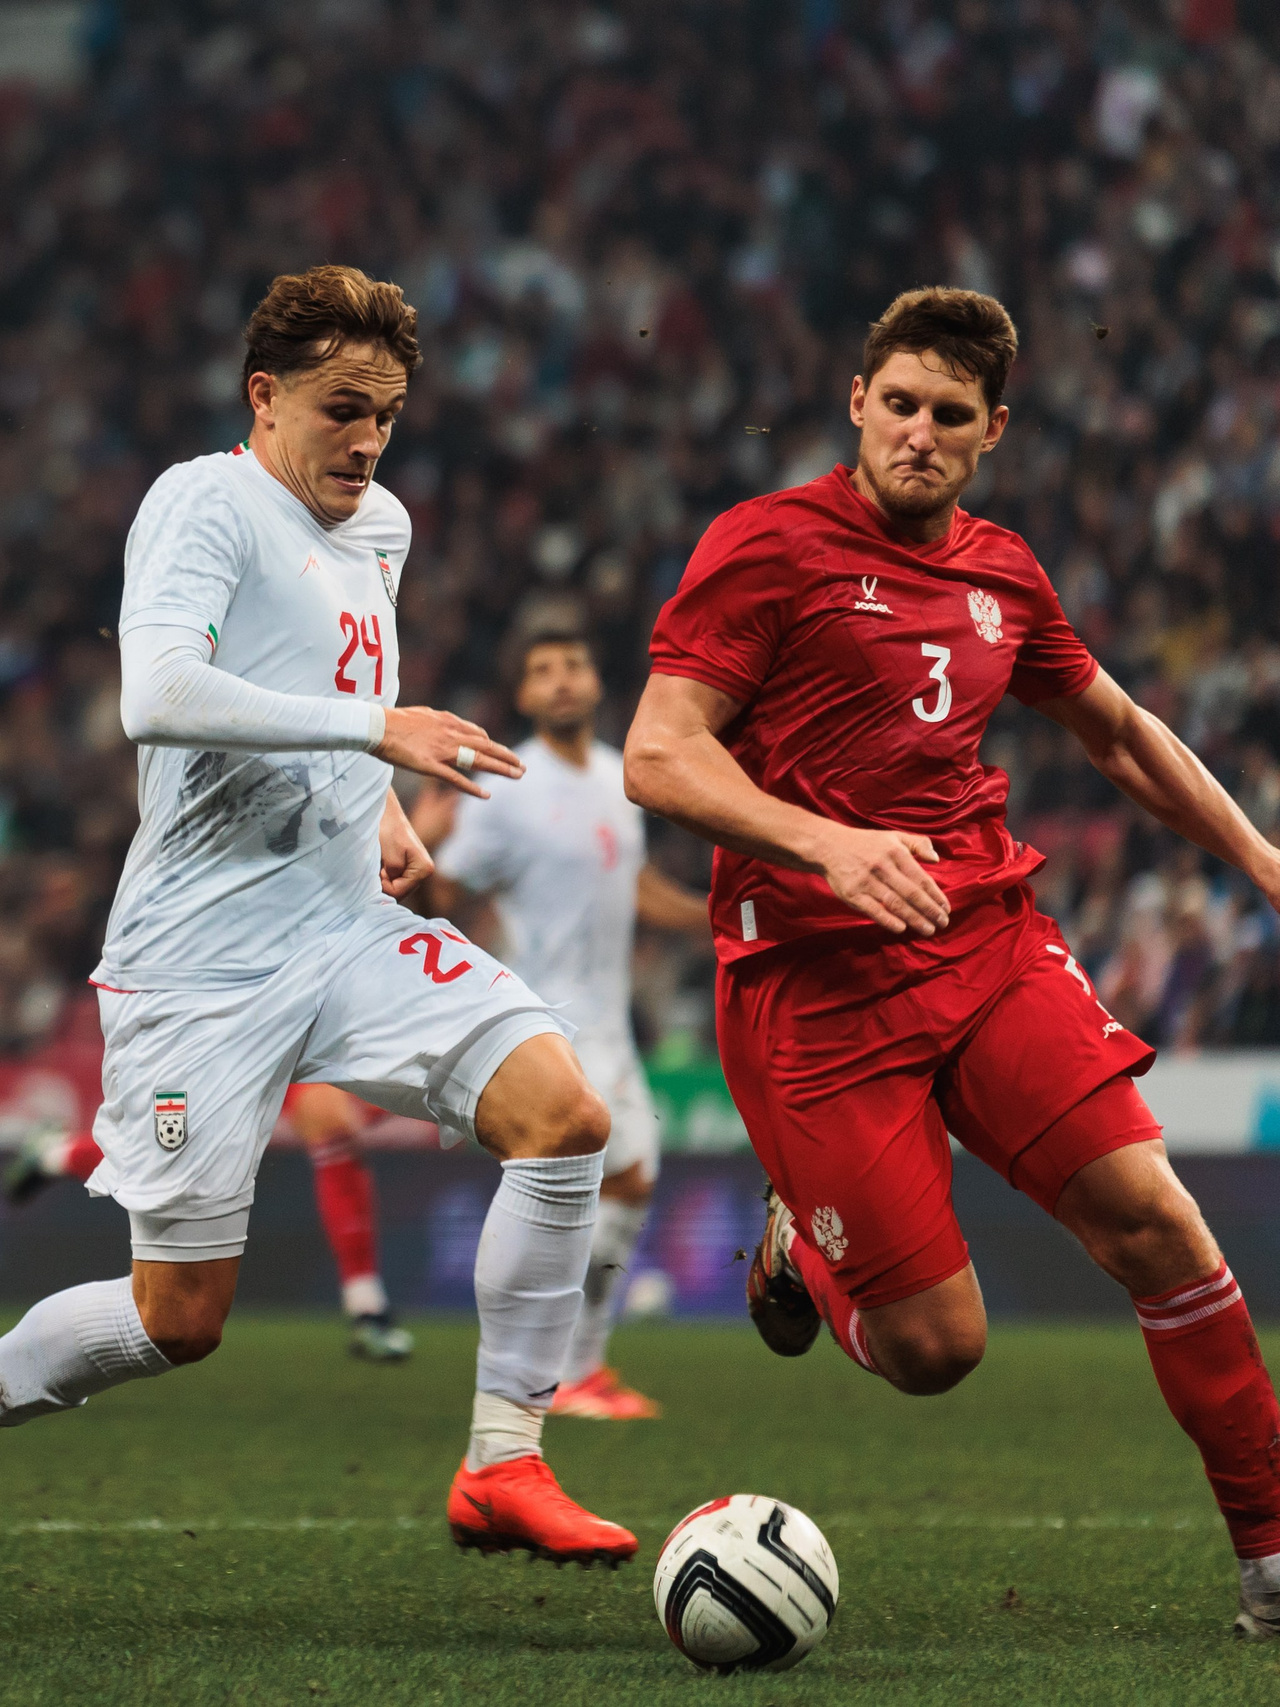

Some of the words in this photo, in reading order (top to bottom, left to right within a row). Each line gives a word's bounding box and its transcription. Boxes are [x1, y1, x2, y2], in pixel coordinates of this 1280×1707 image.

[334, 611, 383, 696] 24
[912, 642, 953, 723] 3
[398, 928, 473, 984] 2
